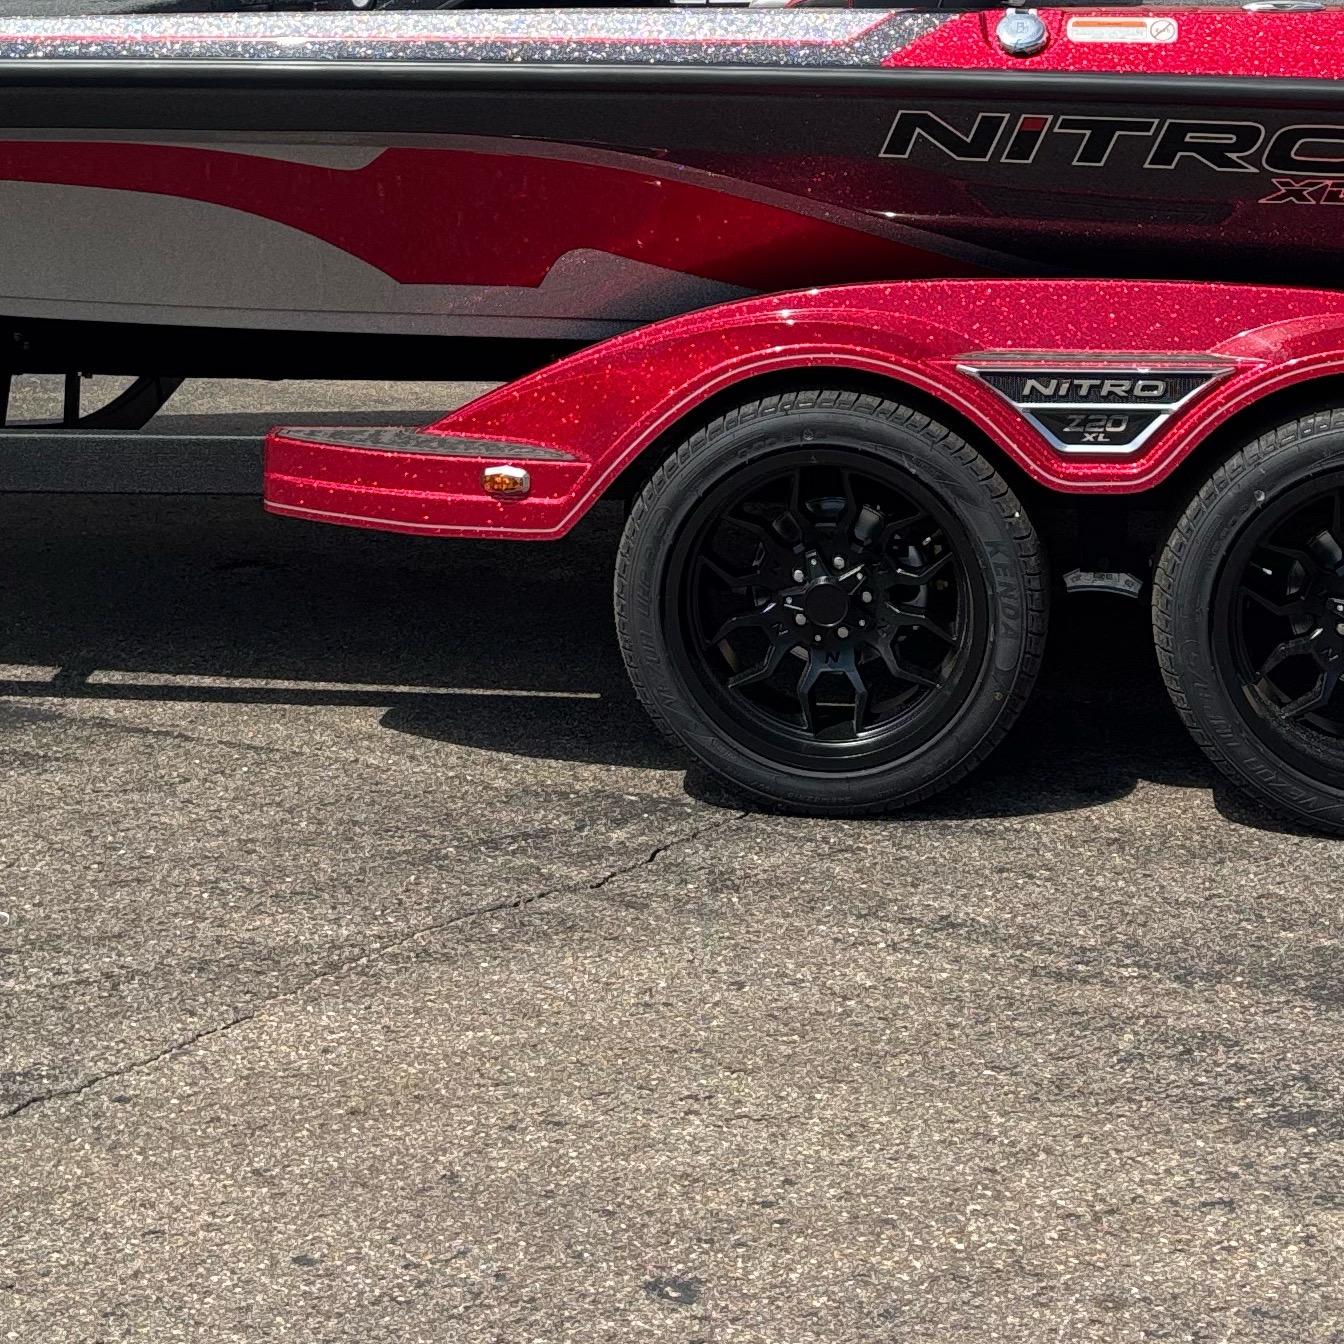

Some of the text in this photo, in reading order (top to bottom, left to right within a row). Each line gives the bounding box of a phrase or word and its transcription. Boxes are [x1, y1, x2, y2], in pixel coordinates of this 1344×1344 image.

[1062, 415, 1129, 432] Z20
[1081, 433, 1111, 442] XL
[985, 541, 1022, 639] KENDA
